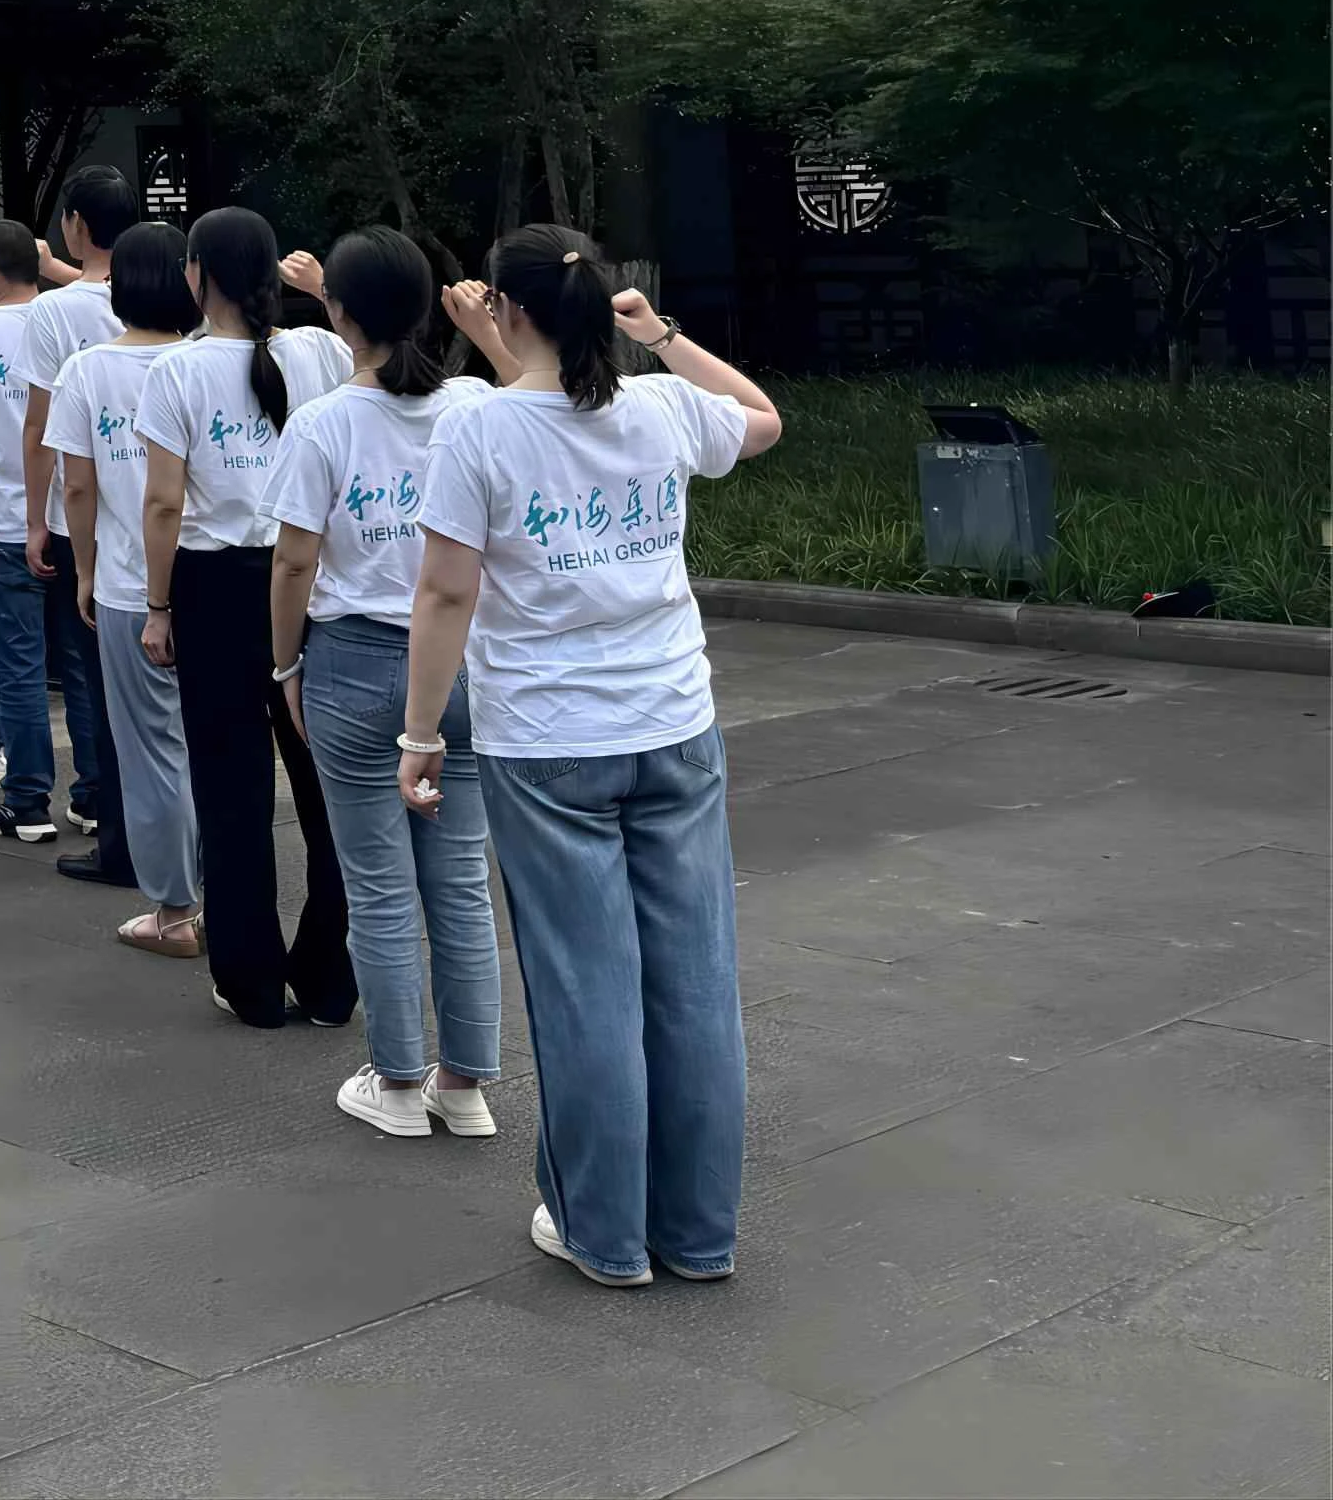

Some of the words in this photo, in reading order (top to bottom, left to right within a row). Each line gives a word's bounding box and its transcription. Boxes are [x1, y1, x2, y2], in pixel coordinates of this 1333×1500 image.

[223, 454, 268, 469] HEHAI
[360, 522, 416, 544] HEHAI
[547, 547, 611, 573] HEHAI
[614, 530, 681, 561] GROUP
